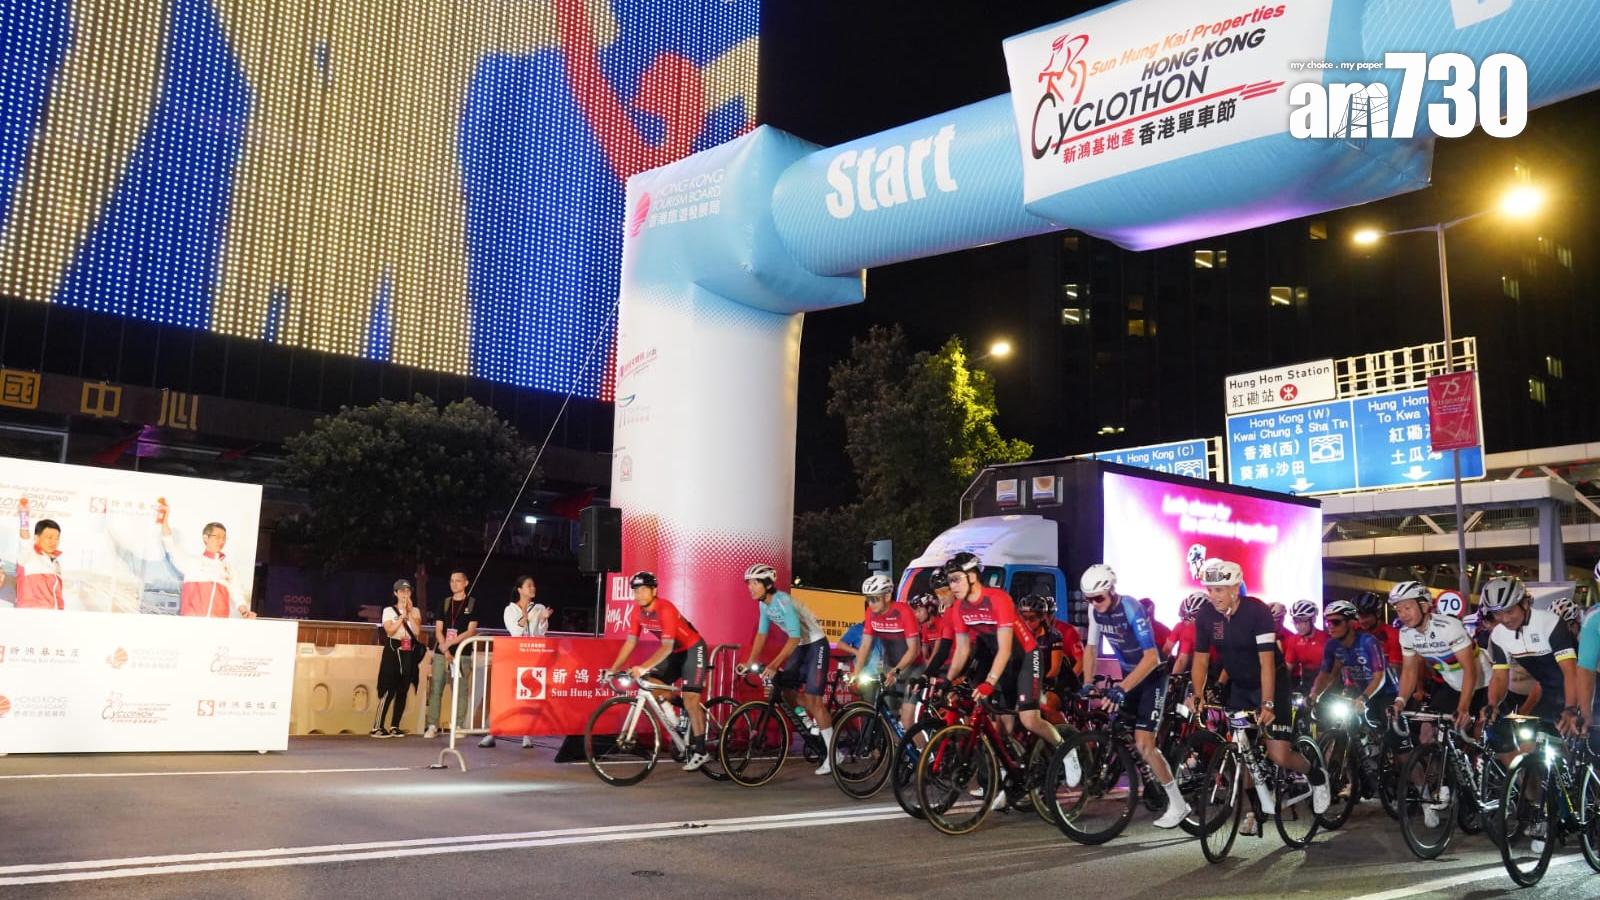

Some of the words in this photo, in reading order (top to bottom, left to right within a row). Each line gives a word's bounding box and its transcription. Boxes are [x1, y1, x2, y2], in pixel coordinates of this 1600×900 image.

[1089, 57, 1117, 78] Sun
[1120, 41, 1157, 67] Hung
[1163, 27, 1189, 48] Kai
[1192, 3, 1286, 41] Properties
[1141, 48, 1199, 82] HONG
[1202, 28, 1267, 61] KONG
[1062, 128, 1135, 164] 新鴻基地產
[1138, 98, 1238, 146] 香港單車節
[825, 123, 959, 220] Start
[1229, 380, 1256, 390] Hung
[1259, 374, 1283, 384] Hom
[1287, 366, 1330, 380] Station
[1249, 417, 1275, 429] Hong
[1278, 413, 1304, 425] Kong
[1308, 407, 1330, 420] (W)
[1367, 400, 1397, 413] Hung
[1376, 412, 1392, 424] To
[1396, 409, 1421, 421] Kwa
[1233, 432, 1257, 443] Kwai
[1259, 427, 1291, 439] Chung
[1295, 424, 1303, 434] &
[1308, 422, 1329, 433] Sha
[1331, 418, 1349, 430] Tin
[1127, 453, 1150, 464] Hong
[1152, 450, 1175, 460] Kong
[1177, 445, 1194, 457] (C)
[1439, 598, 1461, 612] 70
[551, 687, 568, 697] Sun
[570, 687, 593, 698] Hung
[595, 687, 609, 697] Kai
